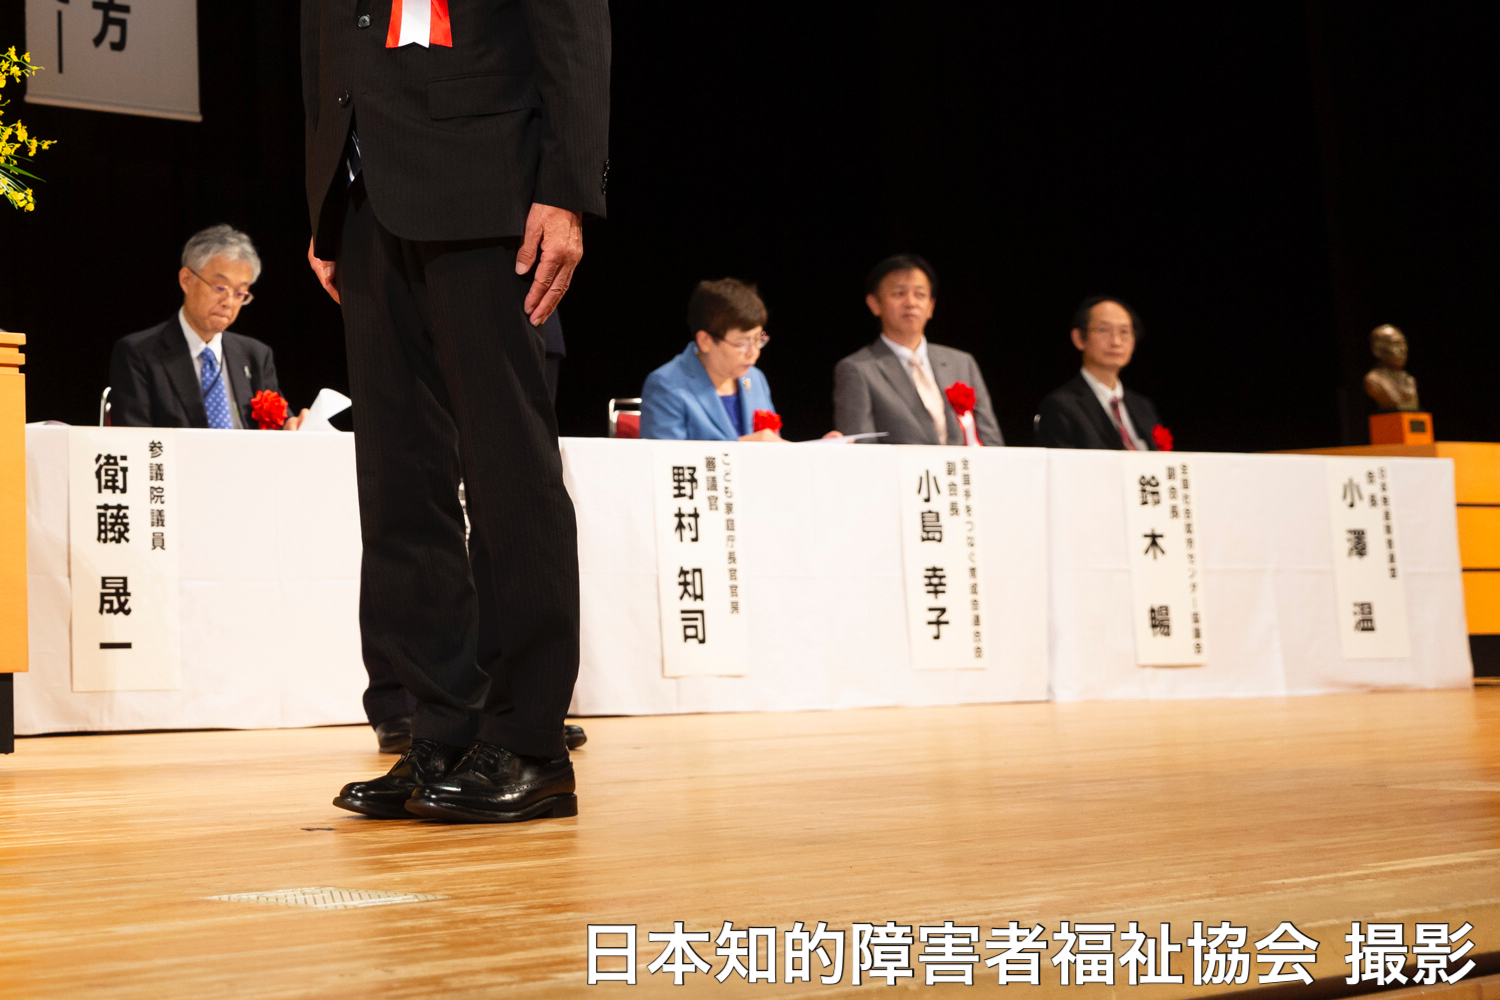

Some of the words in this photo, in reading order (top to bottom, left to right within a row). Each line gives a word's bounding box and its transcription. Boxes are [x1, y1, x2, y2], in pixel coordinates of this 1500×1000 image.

[148, 440, 166, 551] 参議院議員
[705, 456, 719, 511] 審議官
